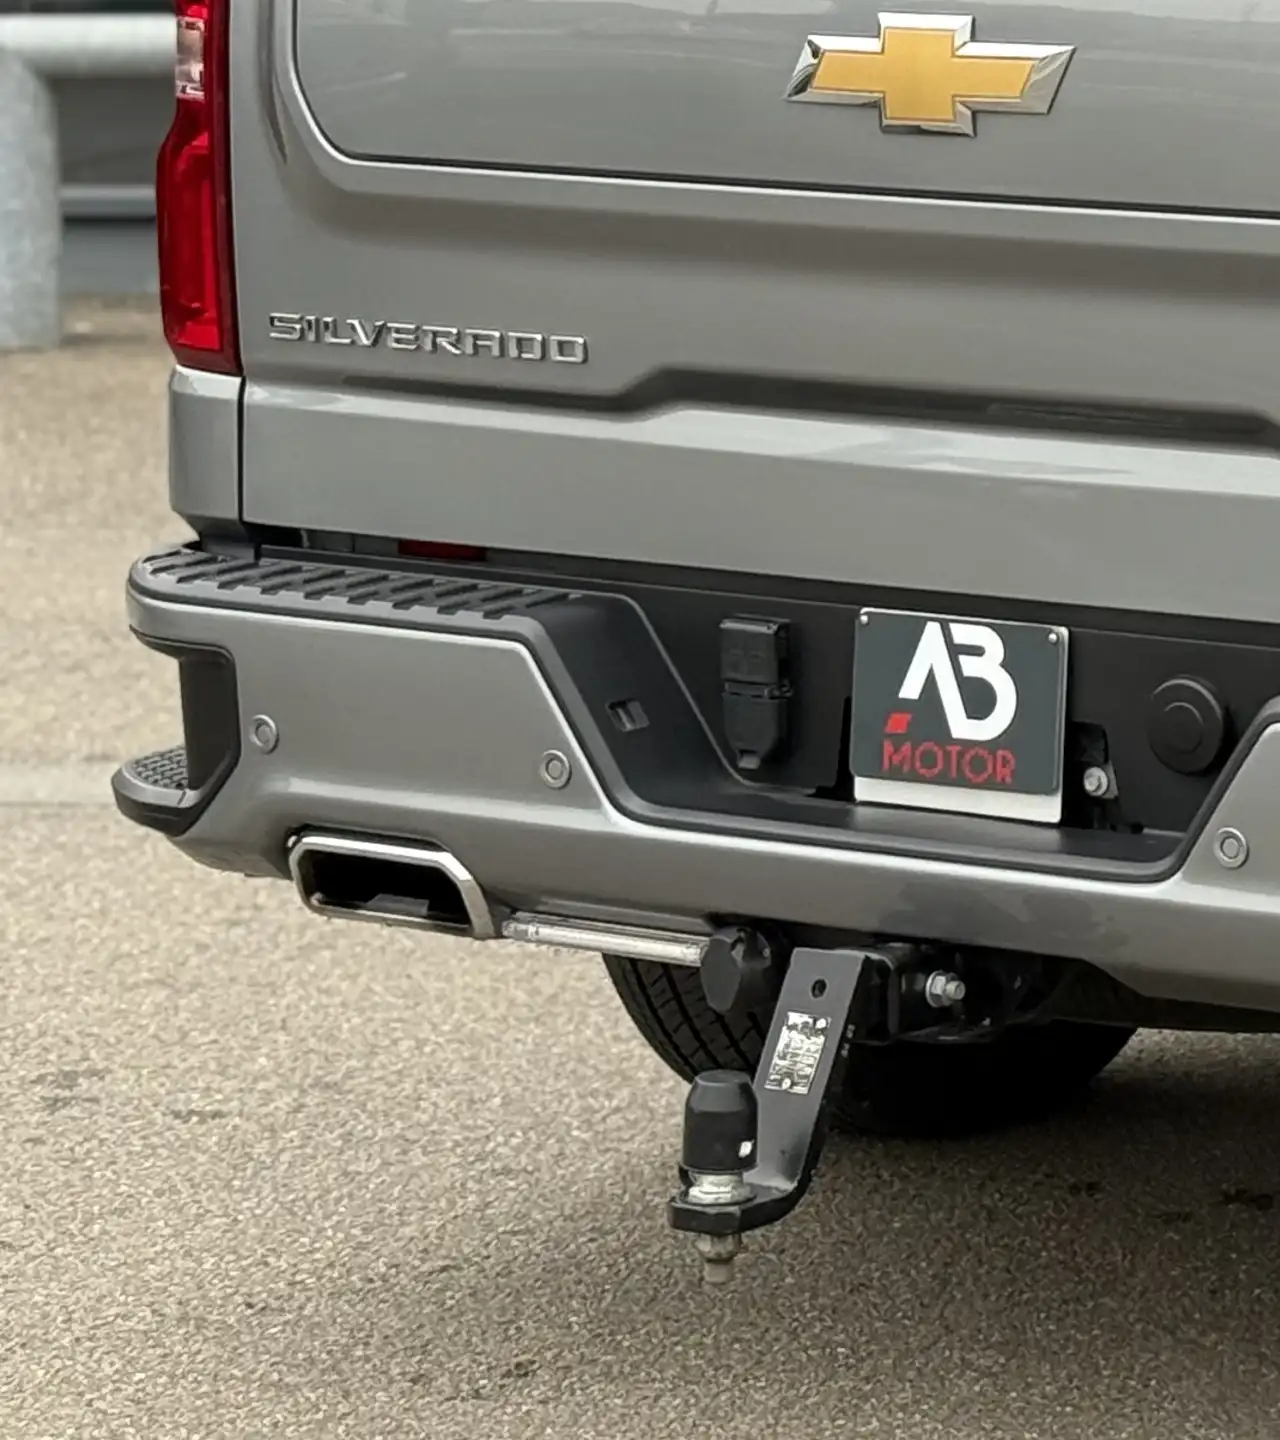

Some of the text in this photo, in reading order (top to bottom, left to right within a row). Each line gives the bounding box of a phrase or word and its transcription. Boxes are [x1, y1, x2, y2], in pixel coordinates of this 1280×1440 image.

[268, 312, 588, 364] SILVERADO
[898, 620, 1018, 742] AB
[882, 739, 1016, 785] MOTOR
